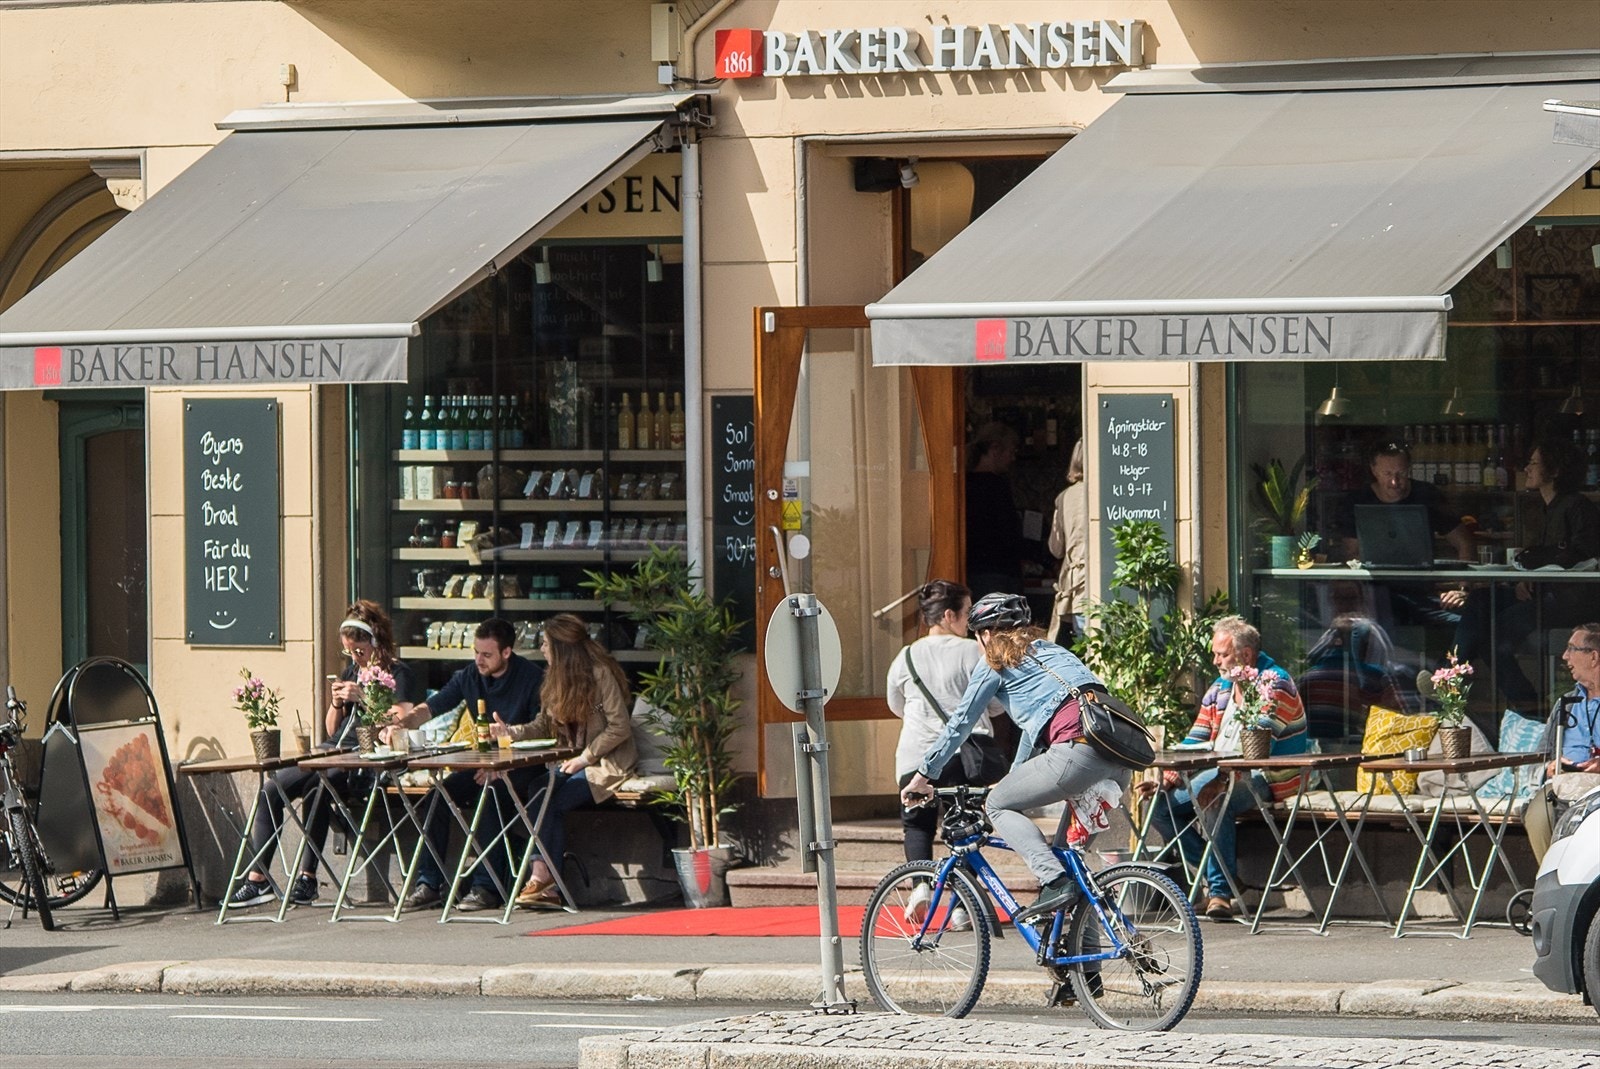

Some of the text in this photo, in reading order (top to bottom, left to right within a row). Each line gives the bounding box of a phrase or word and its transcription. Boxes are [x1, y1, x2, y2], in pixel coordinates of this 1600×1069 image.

[724, 19, 1135, 77] 1861 BAKER HANSEN
[1012, 319, 1144, 358] BAKER
[1159, 316, 1335, 356] HANSEN
[68, 346, 182, 383] BAKER
[193, 343, 345, 381] HANSEN
[726, 422, 748, 445] Sol
[1107, 417, 1167, 440] Åpningstider
[200, 430, 244, 465] Byens
[200, 466, 243, 492] Beste
[1119, 464, 1151, 481] Helger
[1127, 482, 1153, 497] 9-17
[201, 500, 239, 526] Brød
[204, 537, 251, 560] Får du
[204, 564, 249, 594] HER!
